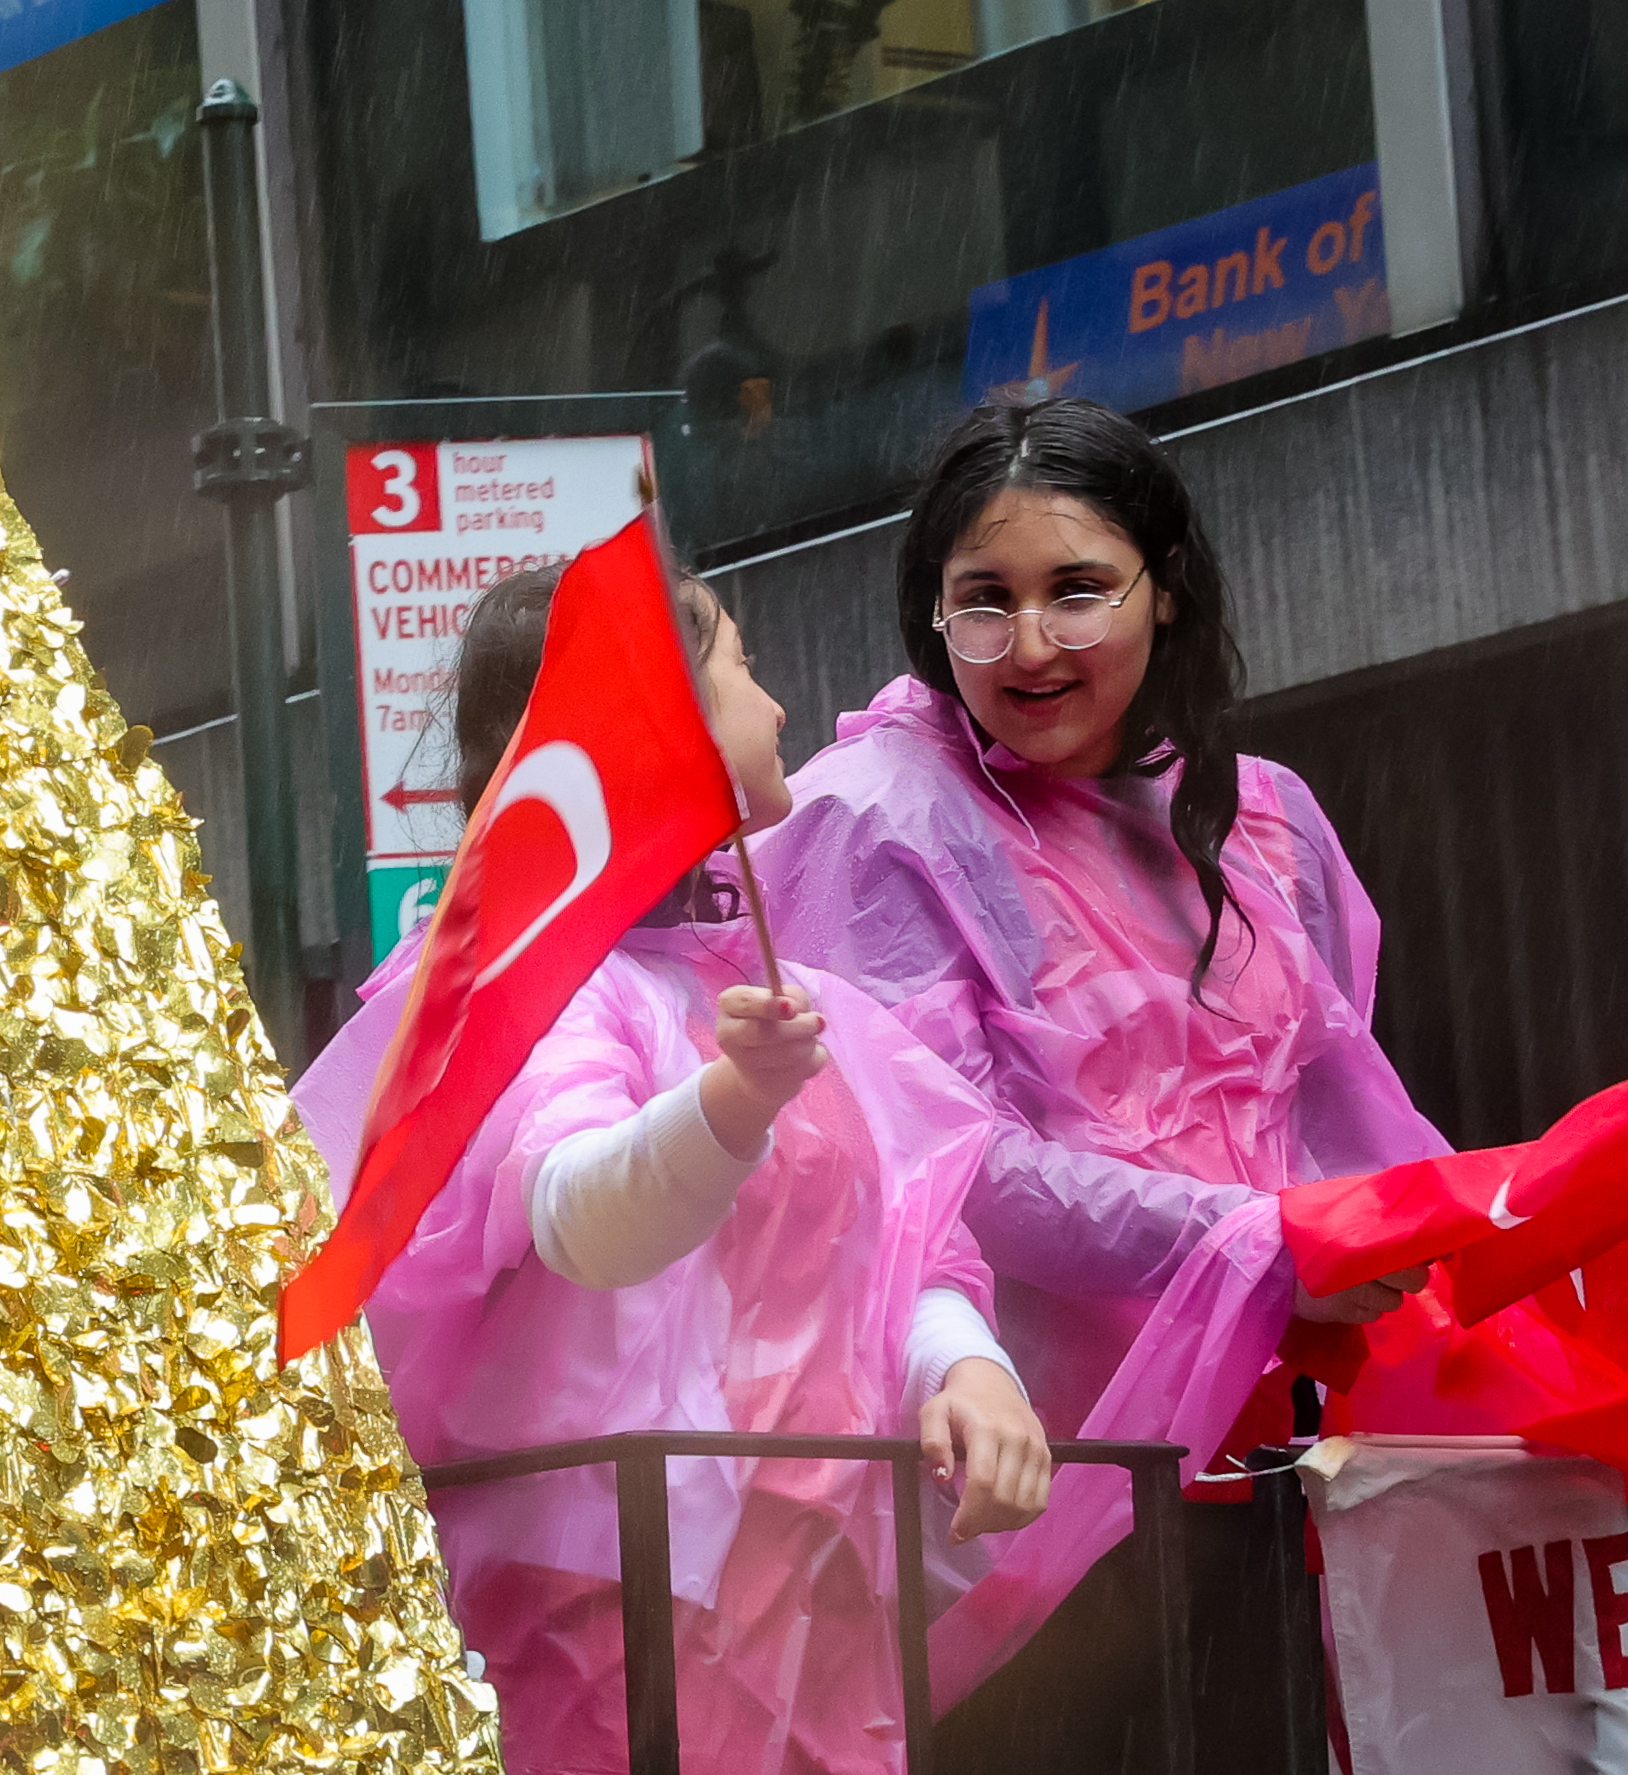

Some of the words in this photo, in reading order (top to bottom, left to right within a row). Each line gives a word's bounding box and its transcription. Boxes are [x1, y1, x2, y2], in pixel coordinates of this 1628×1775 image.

[1128, 226, 1288, 334] Bank
[1306, 190, 1377, 276] of
[452, 451, 507, 474] hour
[370, 449, 423, 528] 3
[454, 476, 555, 503] metered
[455, 506, 544, 536] parking
[370, 602, 472, 641] VEHIC
